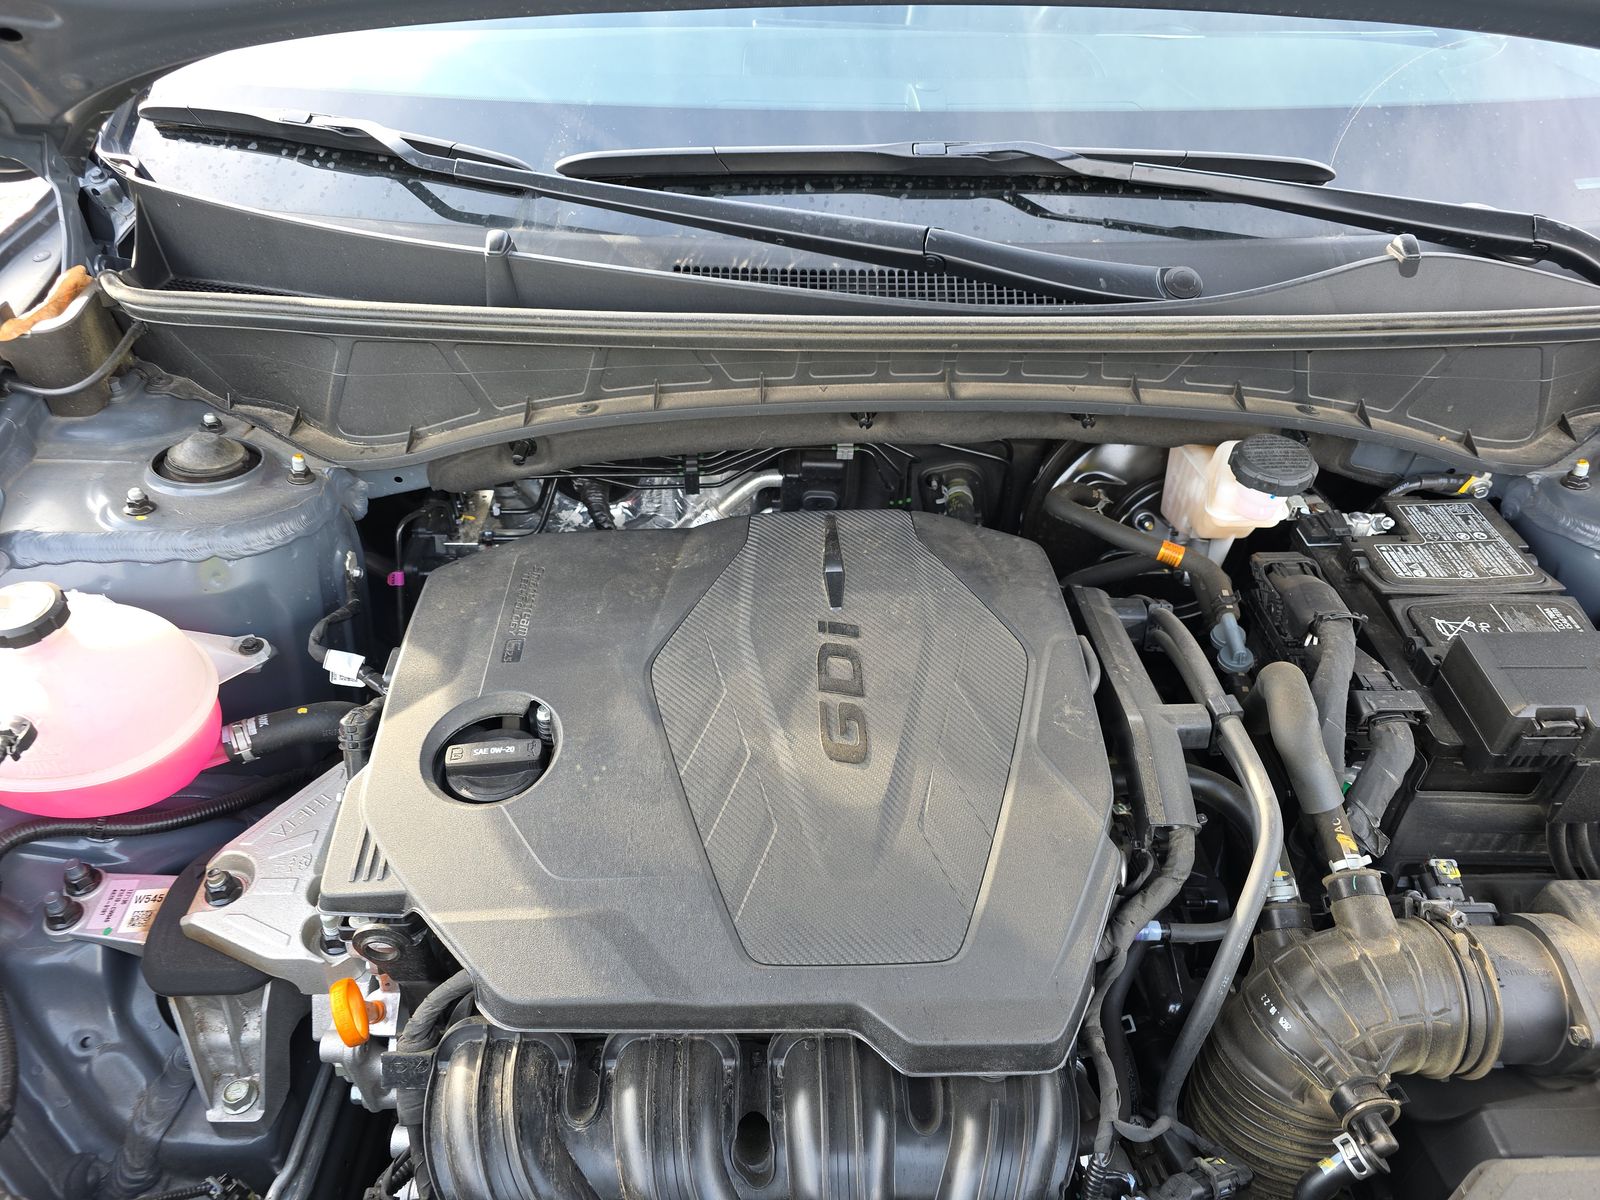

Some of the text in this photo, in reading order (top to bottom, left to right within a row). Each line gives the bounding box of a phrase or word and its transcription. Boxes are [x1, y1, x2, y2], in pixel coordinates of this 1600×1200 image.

[472, 745, 516, 756] SAE 0W-20
[134, 893, 166, 904] W545
